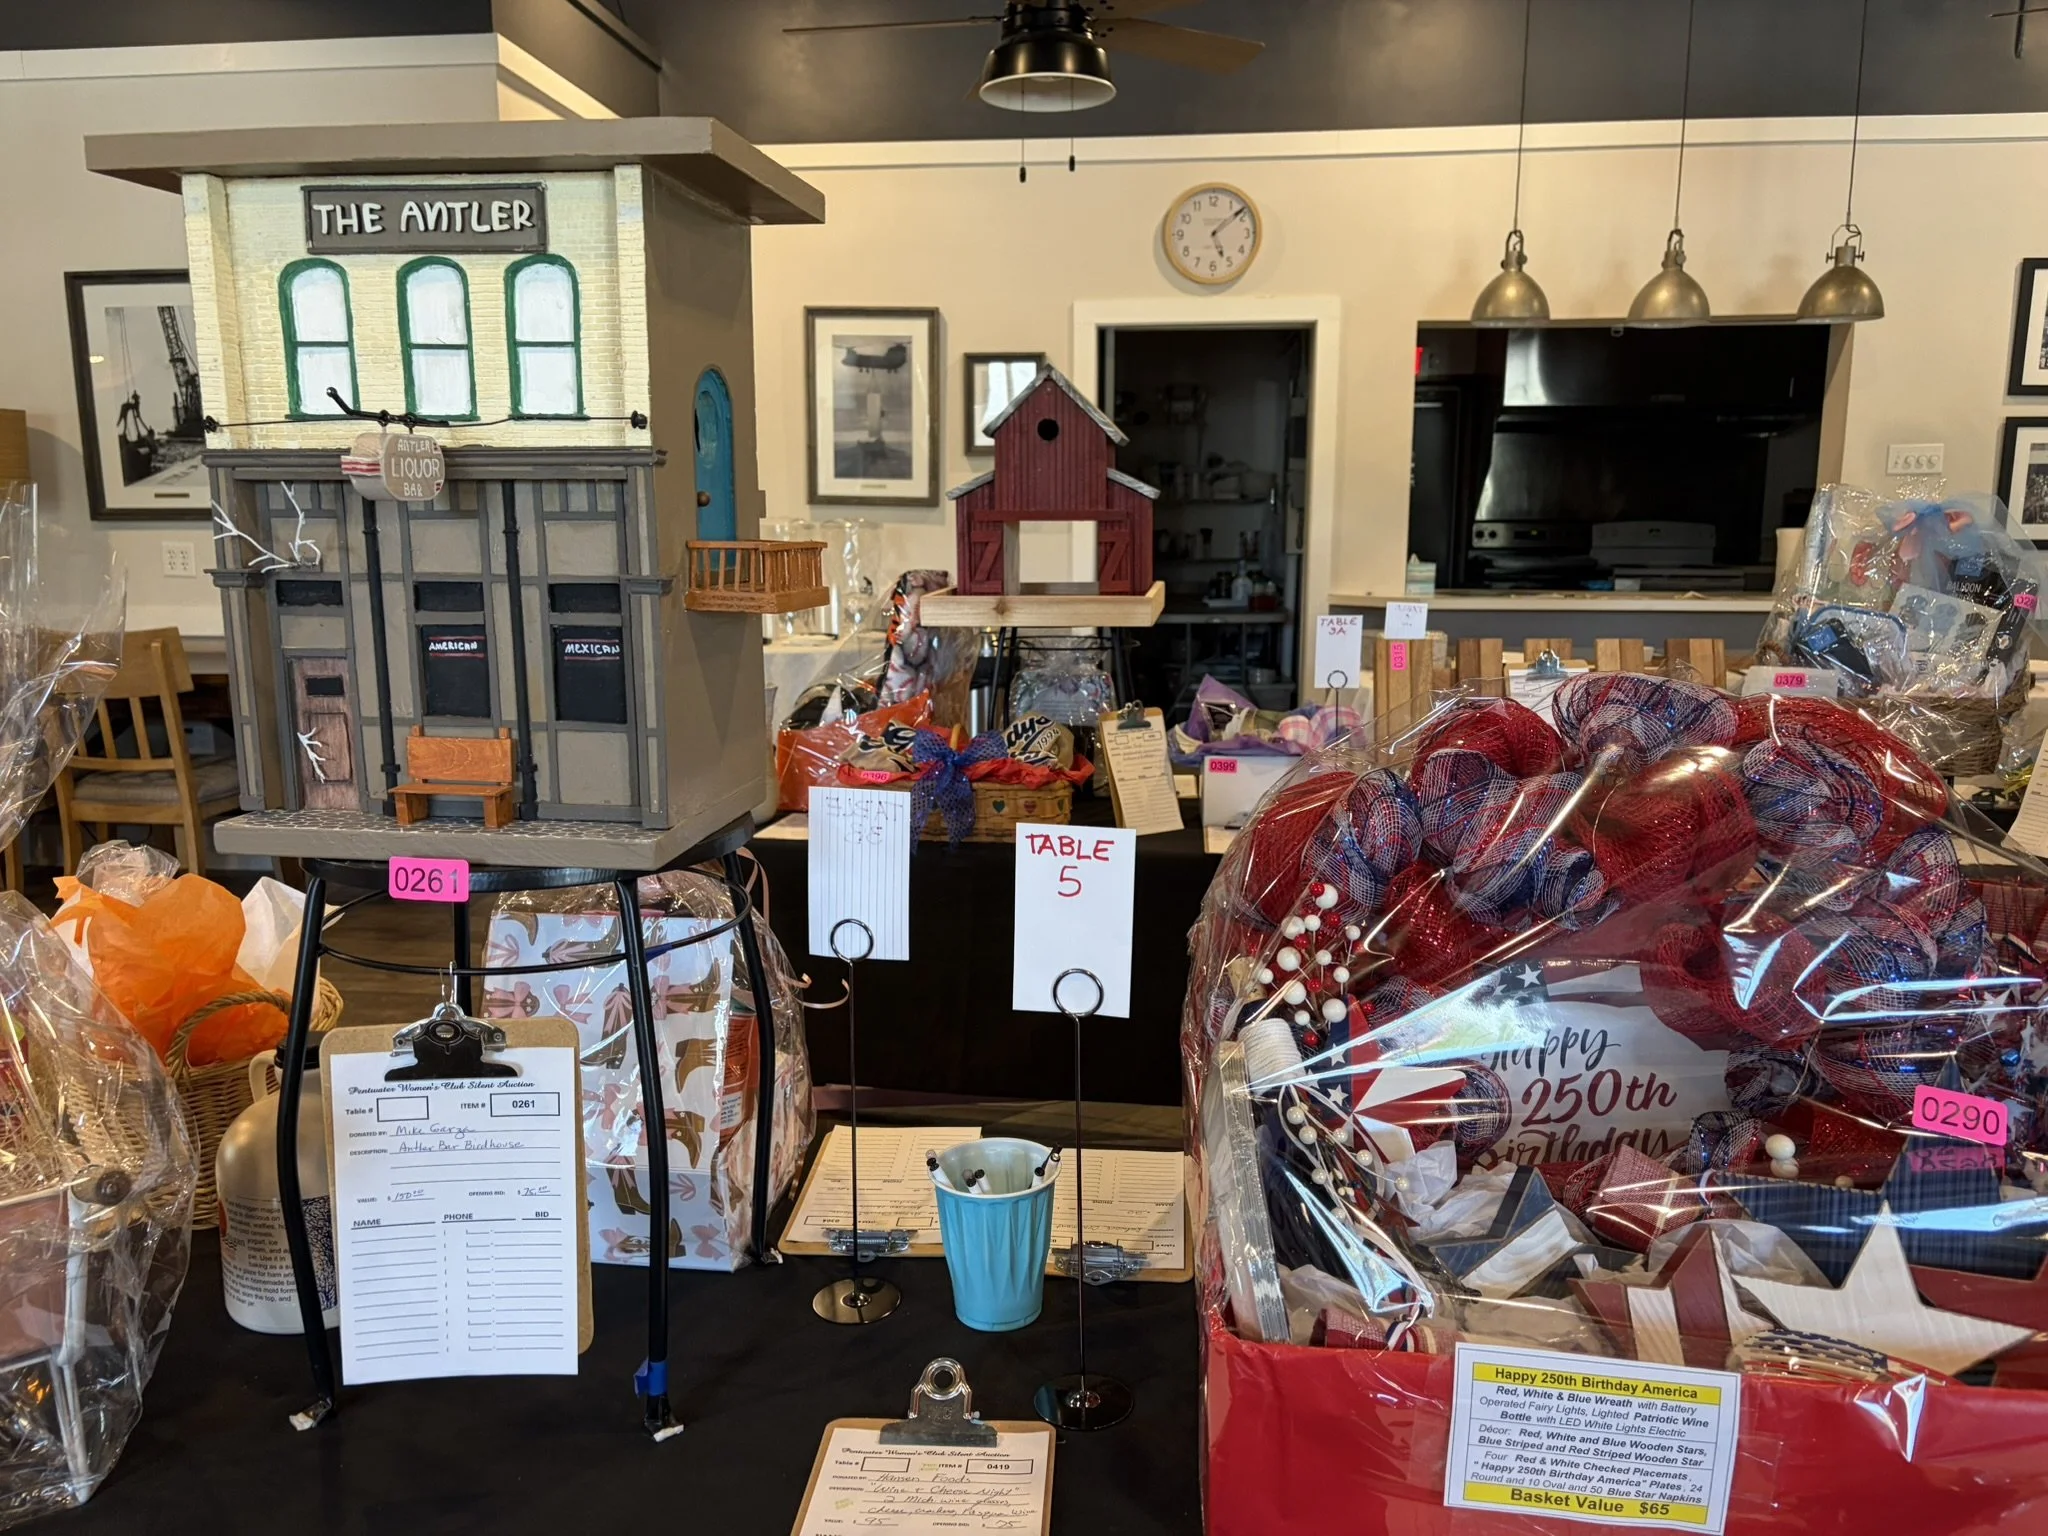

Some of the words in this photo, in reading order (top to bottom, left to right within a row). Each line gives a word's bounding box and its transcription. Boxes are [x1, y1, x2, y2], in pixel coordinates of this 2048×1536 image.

[1193, 200, 1200, 211] 11
[1209, 196, 1218, 206] 12
[312, 202, 383, 235] THE
[400, 200, 534, 233] ANTLER
[1181, 213, 1192, 224] 10
[1176, 229, 1184, 240] 9
[1244, 227, 1250, 240] 3
[1182, 245, 1190, 257] 8
[1238, 244, 1244, 254] 4
[1194, 256, 1200, 268] 7
[1209, 260, 1216, 272] 6
[1226, 256, 1232, 268] 5
[398, 439, 431, 454] ANTLER
[391, 457, 440, 480] LIQUOR
[403, 482, 423, 496] BAR
[1320, 617, 1358, 626] TABLE
[1328, 627, 1346, 636] 3A
[428, 641, 478, 652] AMERICAN
[564, 643, 620, 655] MEXICAN
[1394, 644, 1404, 669] 0315
[1775, 676, 1803, 686] 0379
[1210, 761, 1236, 772] 0399
[1025, 833, 1115, 862] TABLE
[395, 866, 458, 894] 0261
[1058, 866, 1082, 898] 5
[398, 1082, 439, 1092] Women's
[441, 1081, 466, 1090] Club
[467, 1080, 494, 1090] Silent
[498, 1080, 536, 1088] Auction
[460, 1102, 479, 1110] ITEM
[512, 1100, 536, 1109] 0261
[1520, 1068, 1678, 1128] 250th
[1922, 1096, 2000, 1136] 0290
[396, 1124, 425, 1136] Mike
[399, 1141, 435, 1152] Antler
[438, 1140, 460, 1150] Bar
[464, 1138, 524, 1150] Birdhouse
[353, 1218, 382, 1228] NAME
[444, 1213, 474, 1221] PHONE
[534, 1210, 550, 1218] BID
[1495, 1368, 1538, 1384] Happy
[1540, 1372, 1577, 1387] 250th
[1582, 1376, 1639, 1395] Birthday
[1642, 1383, 1698, 1399] America
[1496, 1385, 1520, 1397] Red,
[1523, 1388, 1554, 1400] White
[1556, 1392, 1564, 1400] &
[1567, 1393, 1592, 1404] Blue
[1594, 1396, 1633, 1408] Wreath
[1638, 1400, 1658, 1410] with
[1660, 1402, 1698, 1416] Battery
[1479, 1396, 1526, 1410] Operated
[1528, 1402, 1554, 1414] Fairy
[1556, 1404, 1588, 1417] Lights,
[1592, 1408, 1630, 1420] Lighted
[1634, 1412, 1680, 1425] Patriotic
[1682, 1417, 1709, 1428] Wine
[1500, 1410, 1532, 1422] Bottle
[1536, 1415, 1556, 1424] with
[1558, 1416, 1582, 1427] LED
[1584, 1420, 1614, 1430] White
[1616, 1422, 1646, 1434] Lights
[1648, 1426, 1687, 1438] Electric
[1478, 1424, 1512, 1436] Décor:
[1519, 1428, 1544, 1440] Red,
[1546, 1430, 1577, 1443] White
[1579, 1435, 1600, 1445] and
[1602, 1437, 1627, 1448] Blue
[1630, 1440, 1674, 1453] Wooden
[1676, 1444, 1708, 1457] Stars,
[1478, 1436, 1502, 1446] Blue
[1505, 1439, 1544, 1452] Striped
[1546, 1444, 1566, 1453] and
[1568, 1446, 1590, 1456] Red
[1592, 1448, 1632, 1461] Striped
[1634, 1452, 1678, 1465] Wooden
[1680, 1456, 1704, 1467] Star
[1484, 1450, 1509, 1461] Four
[1514, 1454, 1537, 1464] Red
[1538, 1456, 1547, 1466] &
[1550, 1458, 1580, 1469] White
[1583, 1462, 1630, 1475] Checked
[1518, 1466, 1546, 1476] 250th
[1549, 1470, 1595, 1483] Birthday
[1597, 1475, 1648, 1487] America"
[1690, 1484, 1703, 1493] 24
[1470, 1472, 1503, 1483] Round
[1506, 1476, 1525, 1486] and
[1528, 1478, 1540, 1487] 10
[1542, 1480, 1566, 1490] Oval
[1568, 1483, 1588, 1493] and
[1590, 1485, 1604, 1494] 50
[1607, 1488, 1632, 1498] Blue
[1634, 1490, 1656, 1500] Star
[1658, 1492, 1702, 1504] Napkins
[1510, 1488, 1570, 1507] Basket
[1575, 1495, 1624, 1513] Value
[1640, 1502, 1670, 1516] $65
